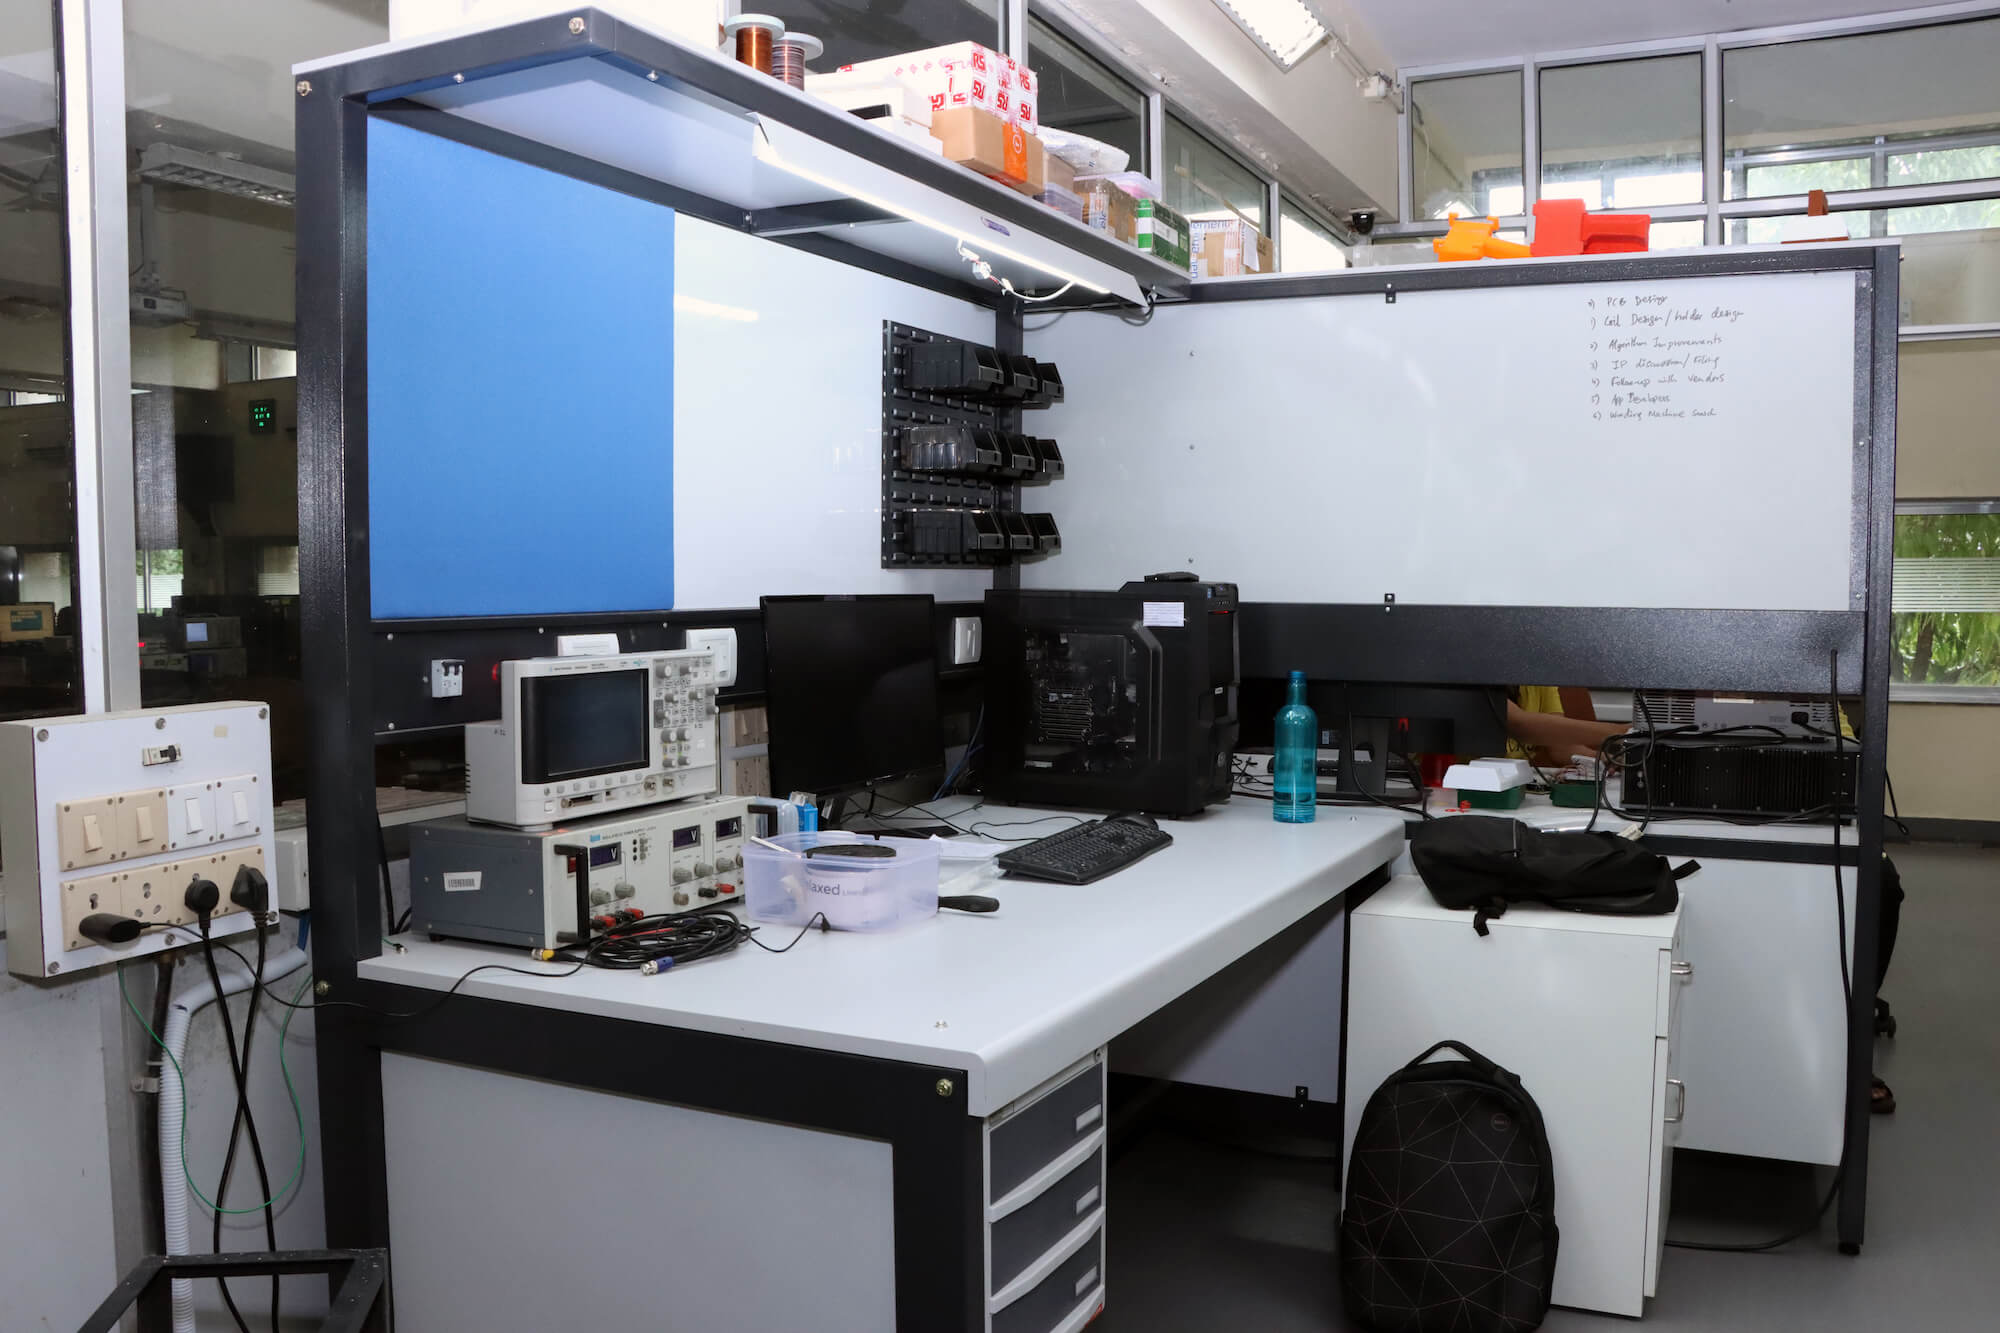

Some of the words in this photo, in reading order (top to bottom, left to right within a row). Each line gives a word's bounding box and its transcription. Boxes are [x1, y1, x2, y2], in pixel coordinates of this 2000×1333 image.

[973, 52, 986, 71] RS
[1020, 72, 1031, 91] RS
[1711, 306, 1745, 323] design
[690, 829, 697, 842] V
[610, 847, 617, 860] V
